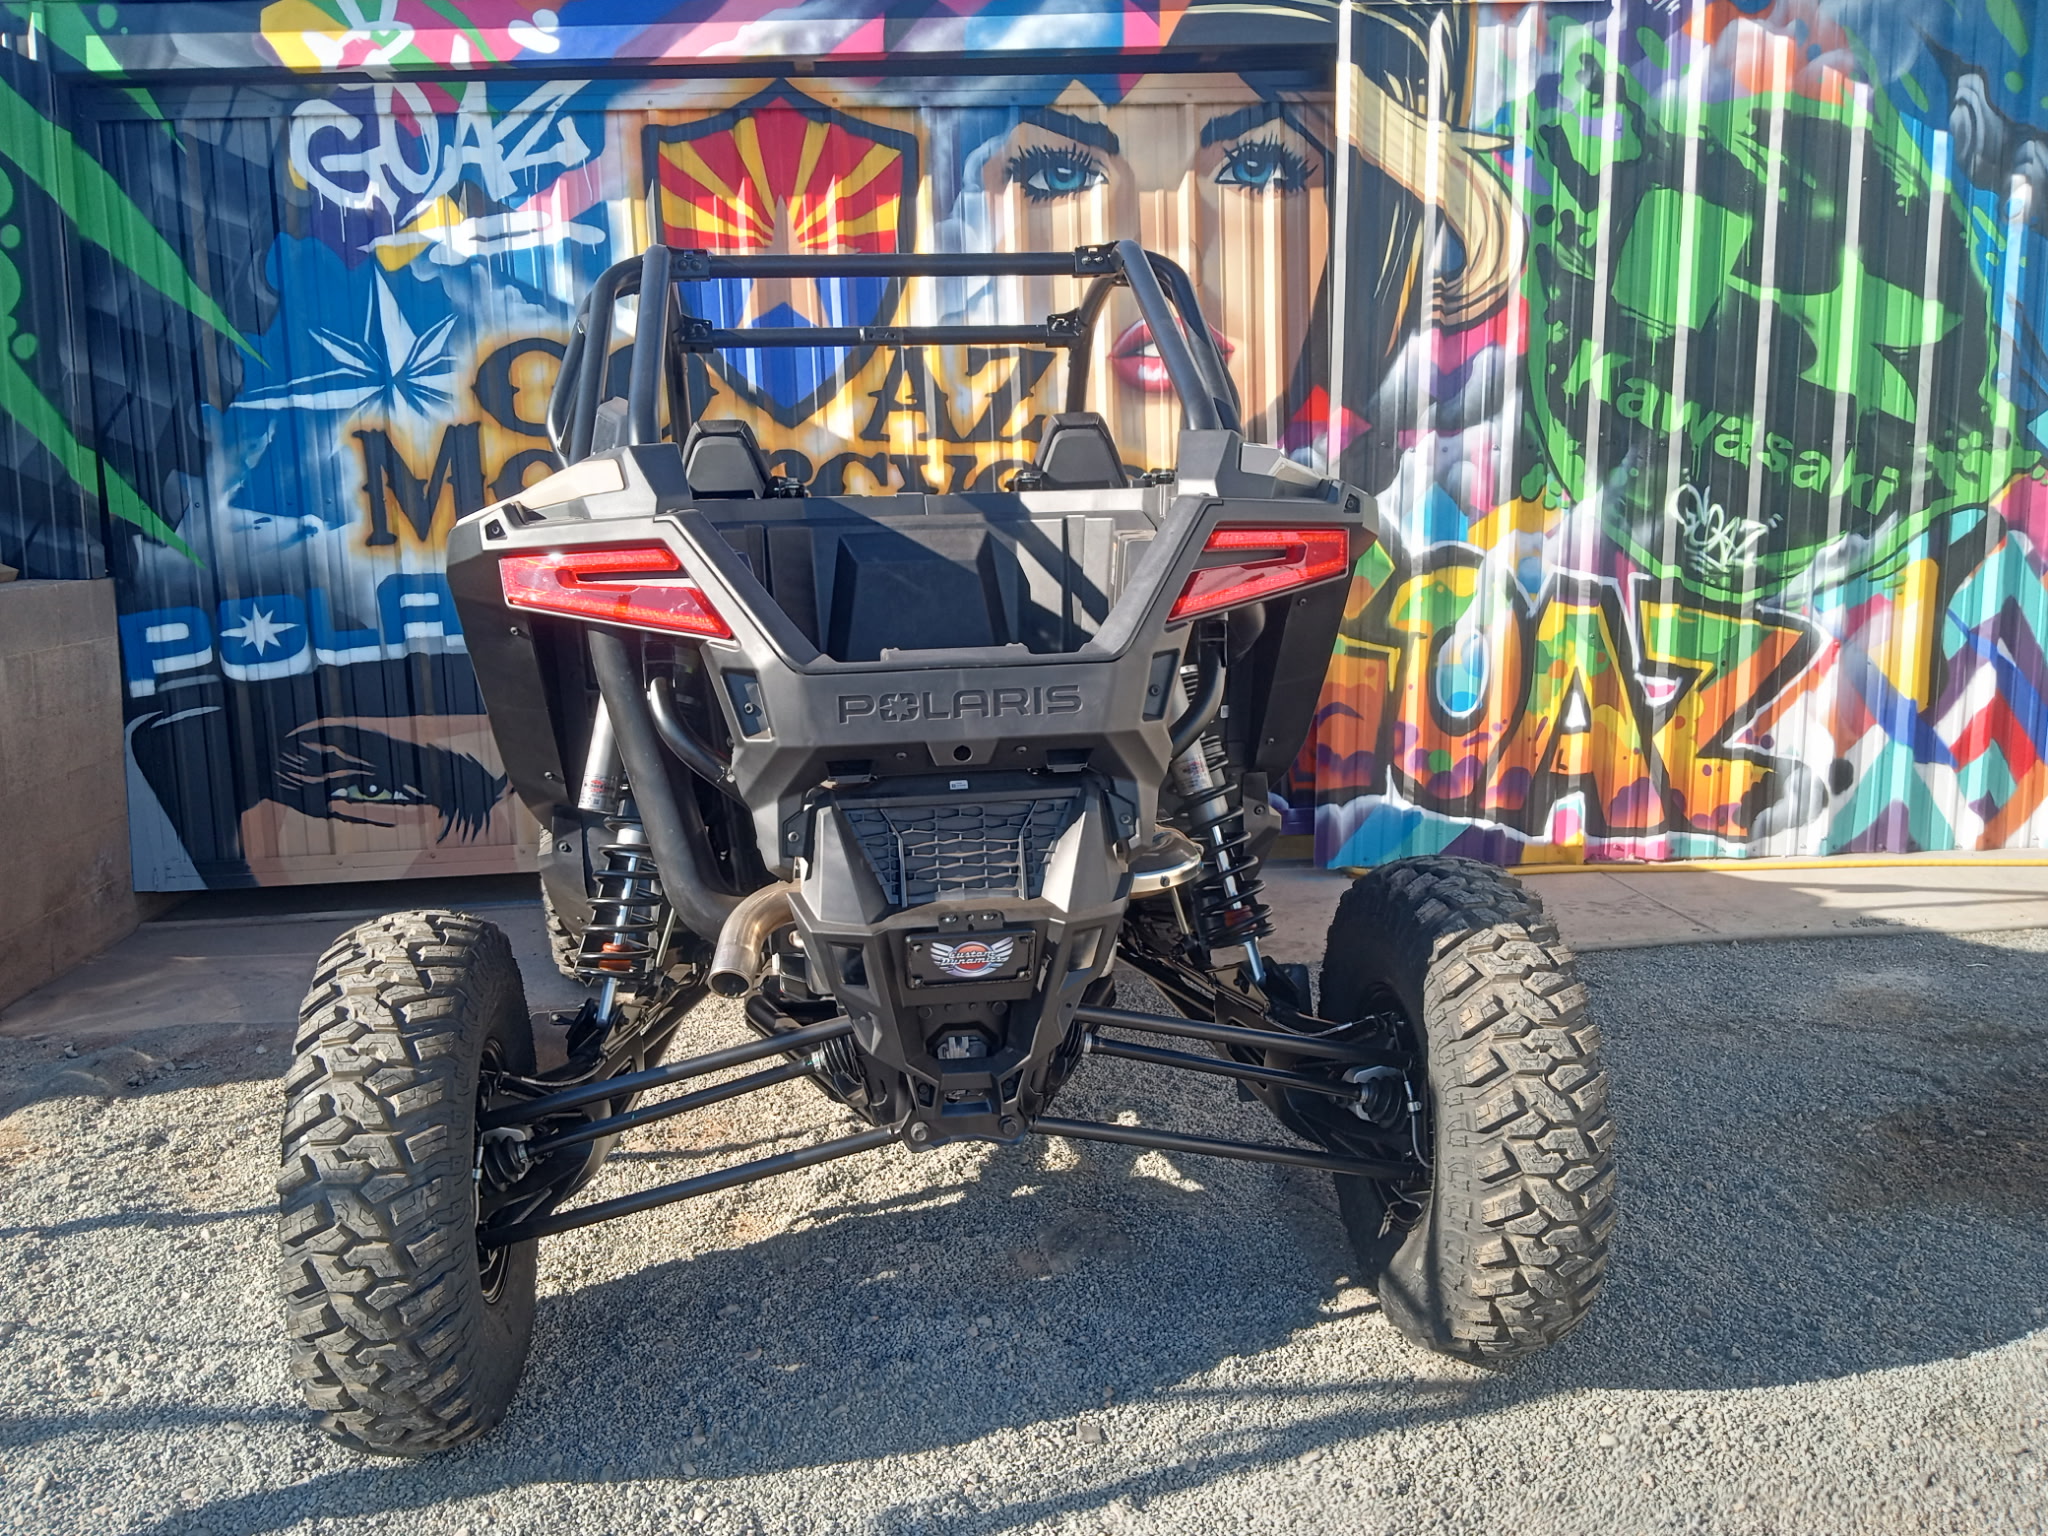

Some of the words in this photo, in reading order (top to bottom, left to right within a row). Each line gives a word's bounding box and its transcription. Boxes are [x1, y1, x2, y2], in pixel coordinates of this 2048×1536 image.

[859, 346, 1057, 443] AZ
[838, 684, 1084, 725] POLARIS
[940, 955, 1002, 967] Dynamics
[948, 949, 995, 959] Custom
